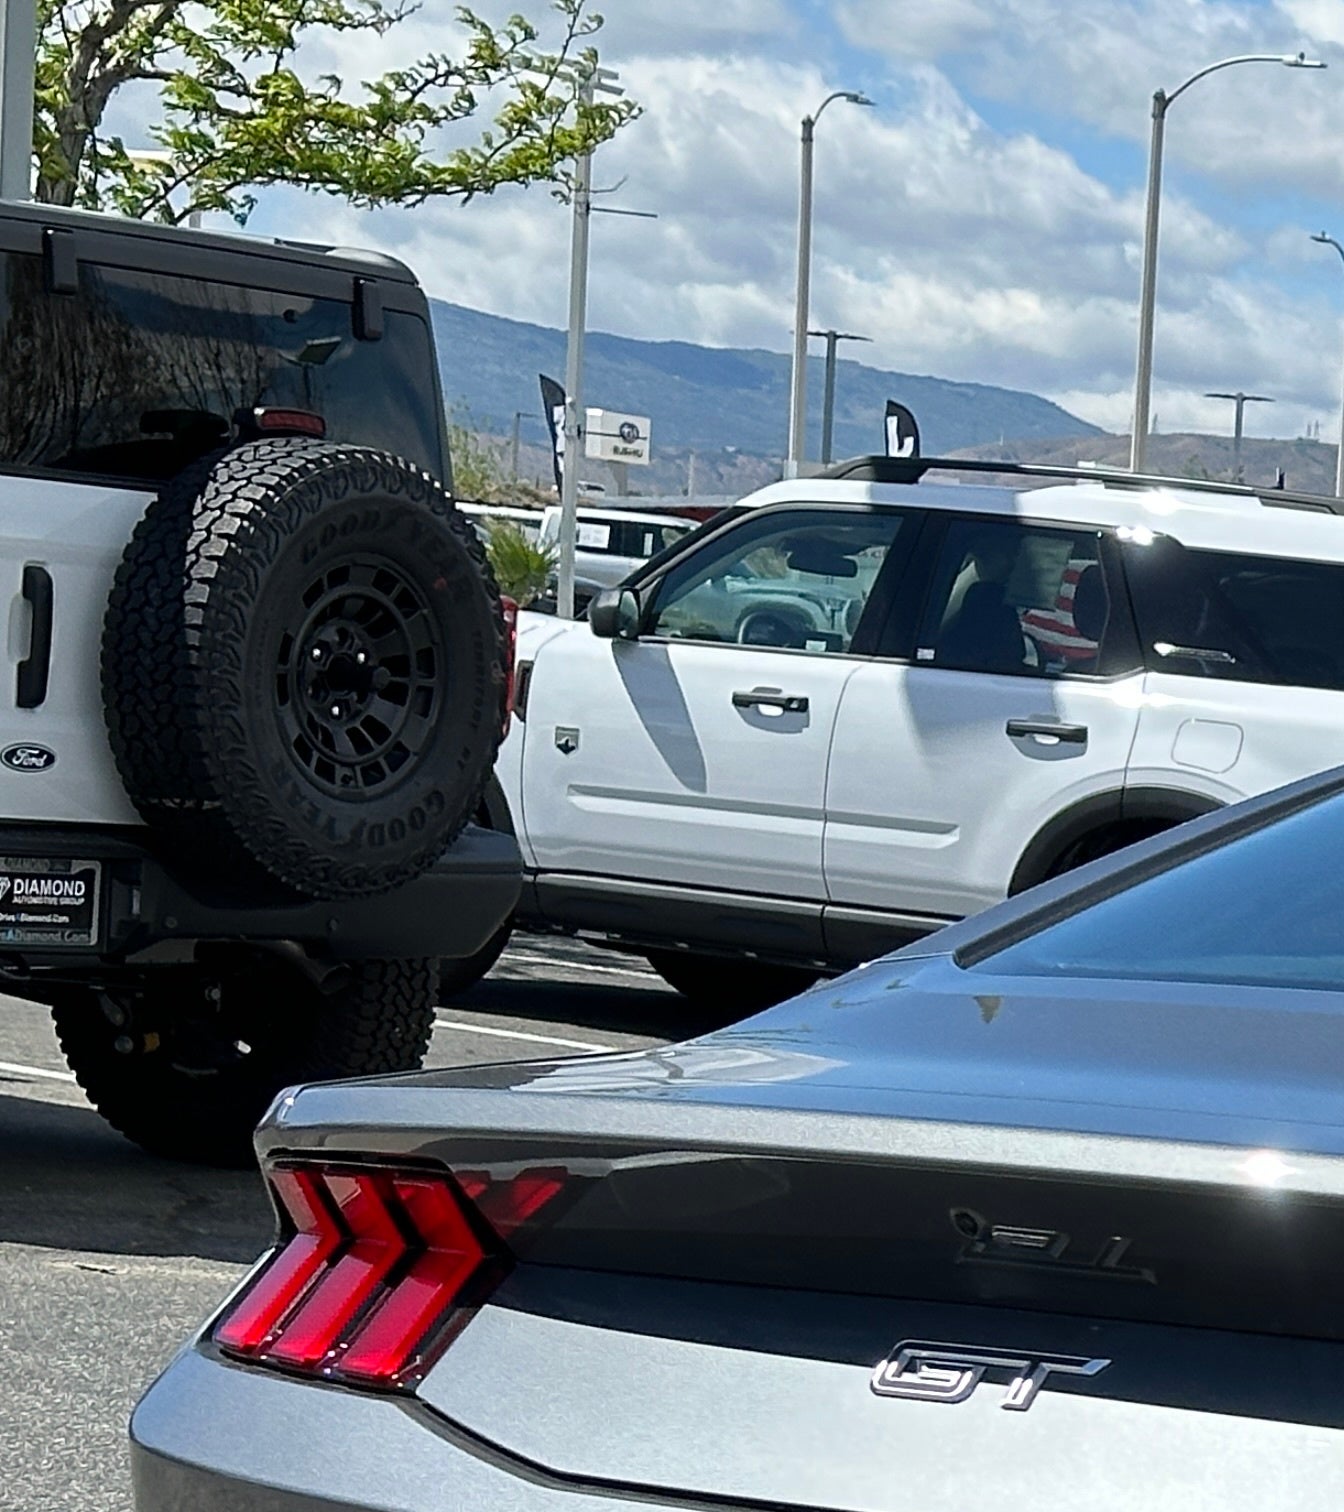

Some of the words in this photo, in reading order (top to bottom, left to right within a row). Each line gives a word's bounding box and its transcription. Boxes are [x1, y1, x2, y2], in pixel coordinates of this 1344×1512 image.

[11, 748, 47, 767] Ford
[13, 879, 86, 896] DIAMOND
[870, 1338, 1112, 1412] GT
